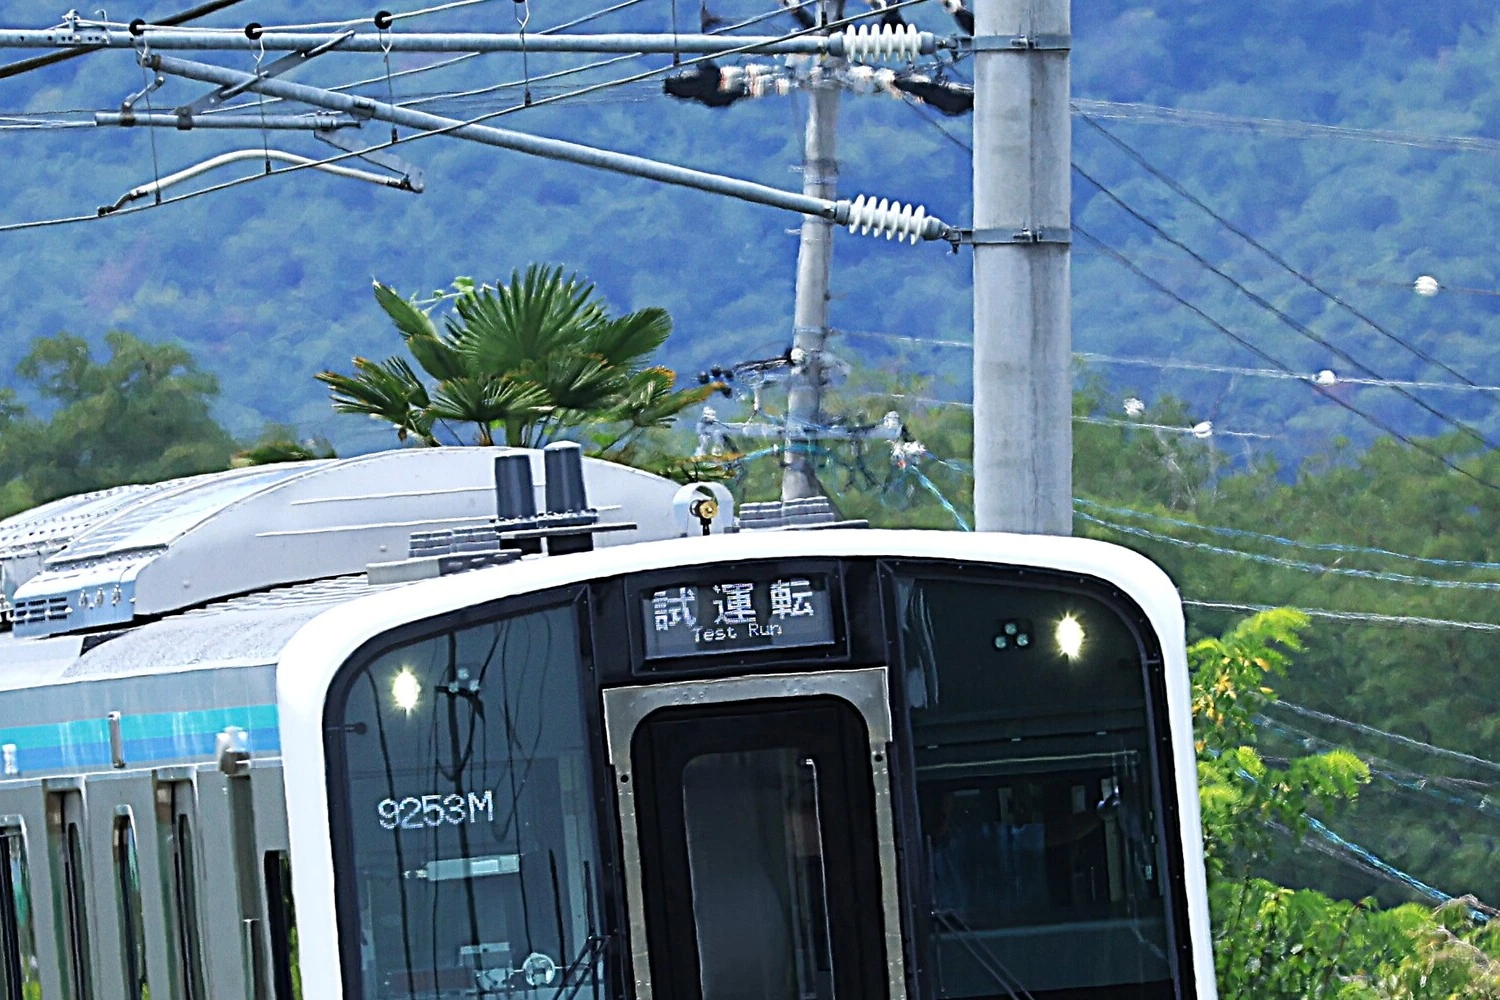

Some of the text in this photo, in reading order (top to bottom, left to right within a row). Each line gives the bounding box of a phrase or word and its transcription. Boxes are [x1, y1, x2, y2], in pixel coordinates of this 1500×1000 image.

[652, 579, 814, 631] 試運転
[691, 622, 783, 643] Test Run
[377, 790, 494, 830] 9253M
